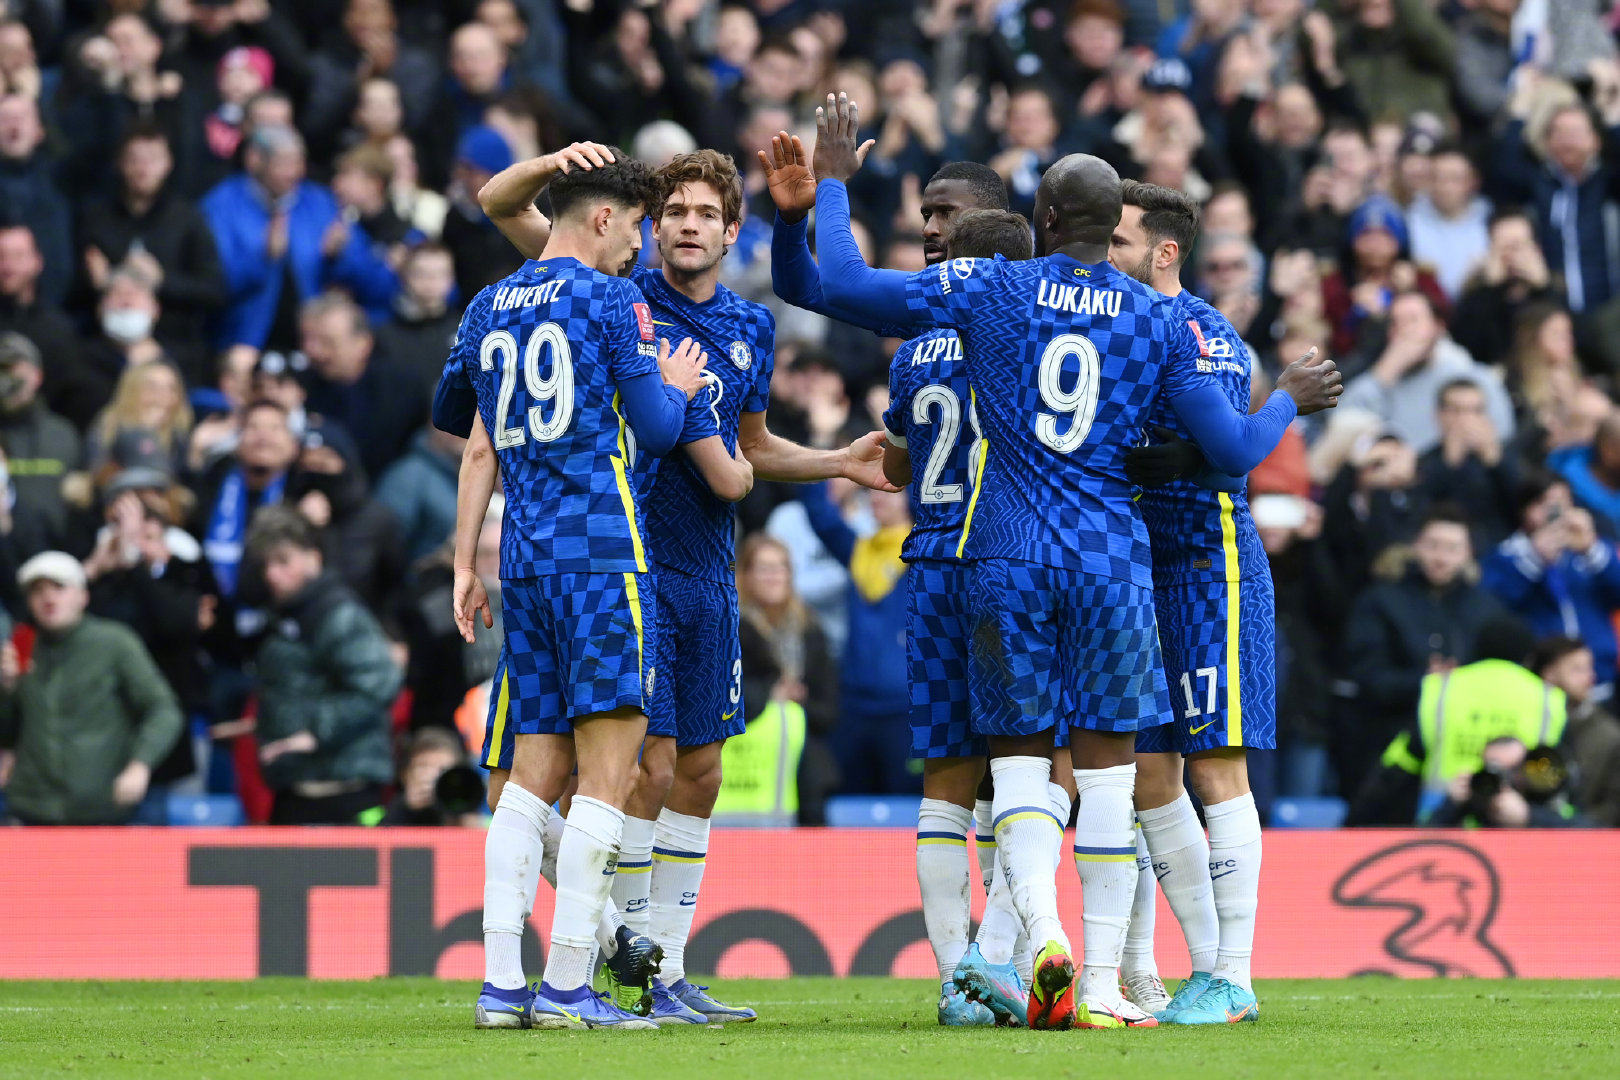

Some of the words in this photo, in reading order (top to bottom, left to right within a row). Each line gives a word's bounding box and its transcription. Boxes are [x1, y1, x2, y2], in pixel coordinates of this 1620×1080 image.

[534, 266, 548, 274] CFC
[1073, 267, 1092, 278] CFC
[492, 279, 566, 311] HAVERTZ
[1036, 279, 1123, 318] LUKAKU
[479, 321, 575, 451] 29
[1034, 333, 1101, 455] 9
[911, 383, 982, 504] 2
[729, 658, 742, 704] 3
[1180, 665, 1218, 719] 17
[606, 860, 619, 868] CF
[1135, 856, 1150, 864] FC
[1152, 861, 1169, 872] FC
[1208, 859, 1237, 871] CFC
[682, 891, 699, 899] CF
